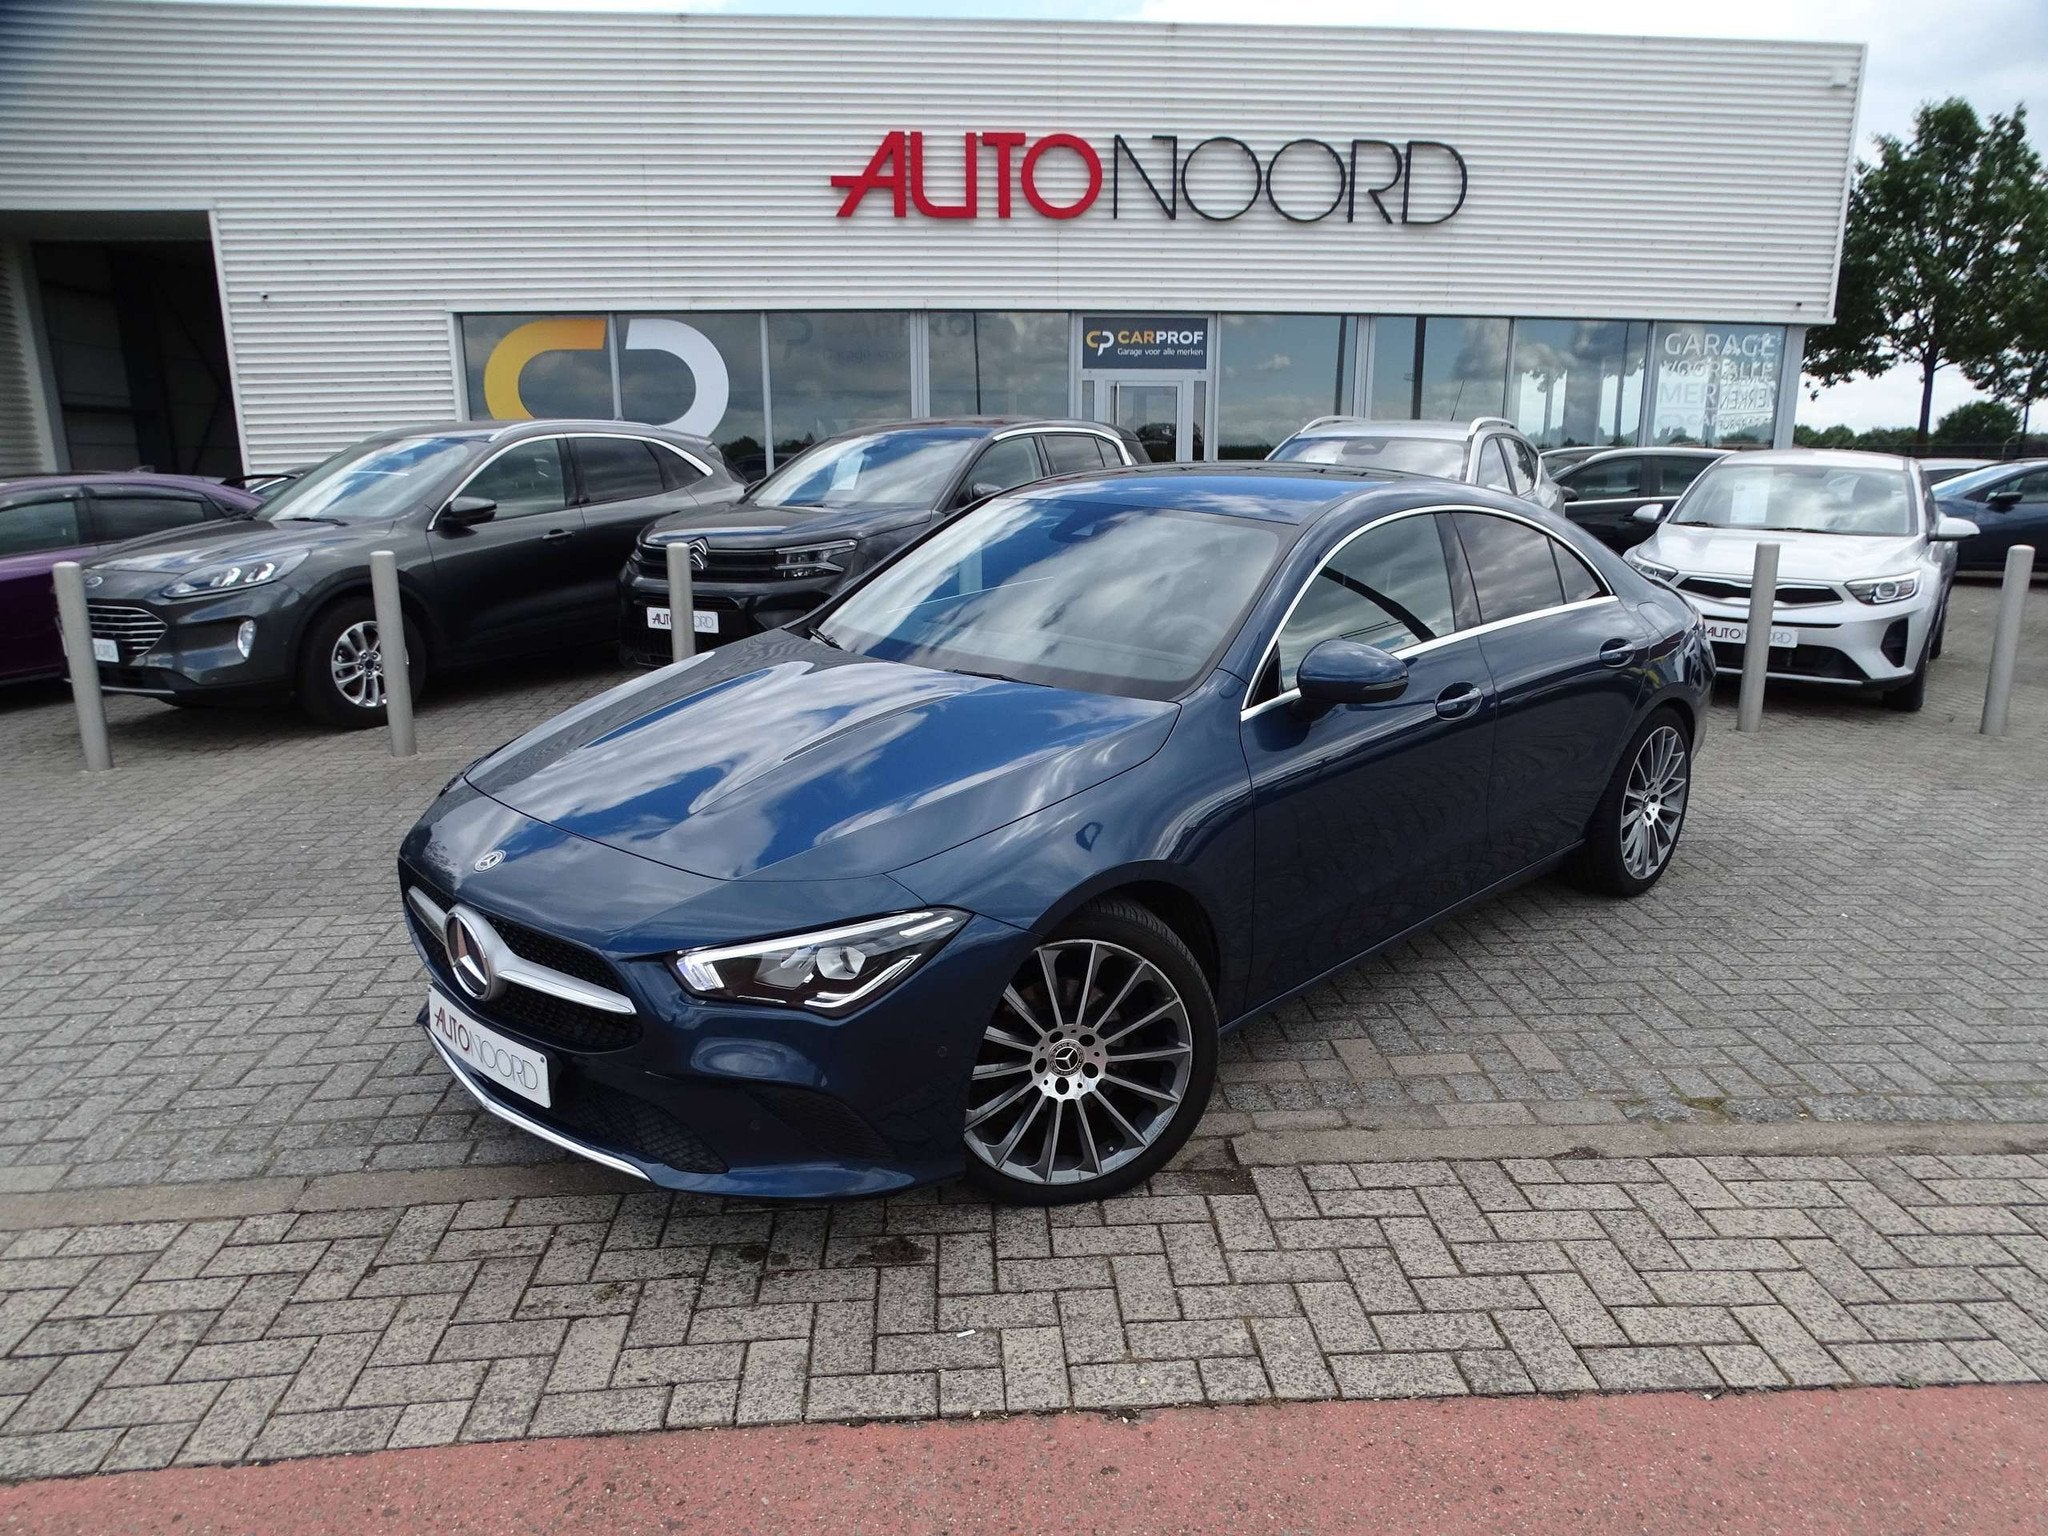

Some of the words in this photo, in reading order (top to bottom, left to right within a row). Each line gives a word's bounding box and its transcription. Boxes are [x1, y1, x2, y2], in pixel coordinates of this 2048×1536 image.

[1117, 330, 1204, 345] CARPROF
[1664, 332, 1776, 357] GARAGE
[1117, 347, 1142, 357] Garage
[1163, 347, 1175, 356] alle
[1177, 347, 1204, 356] merken
[435, 1006, 539, 1091] AUTONOORD
